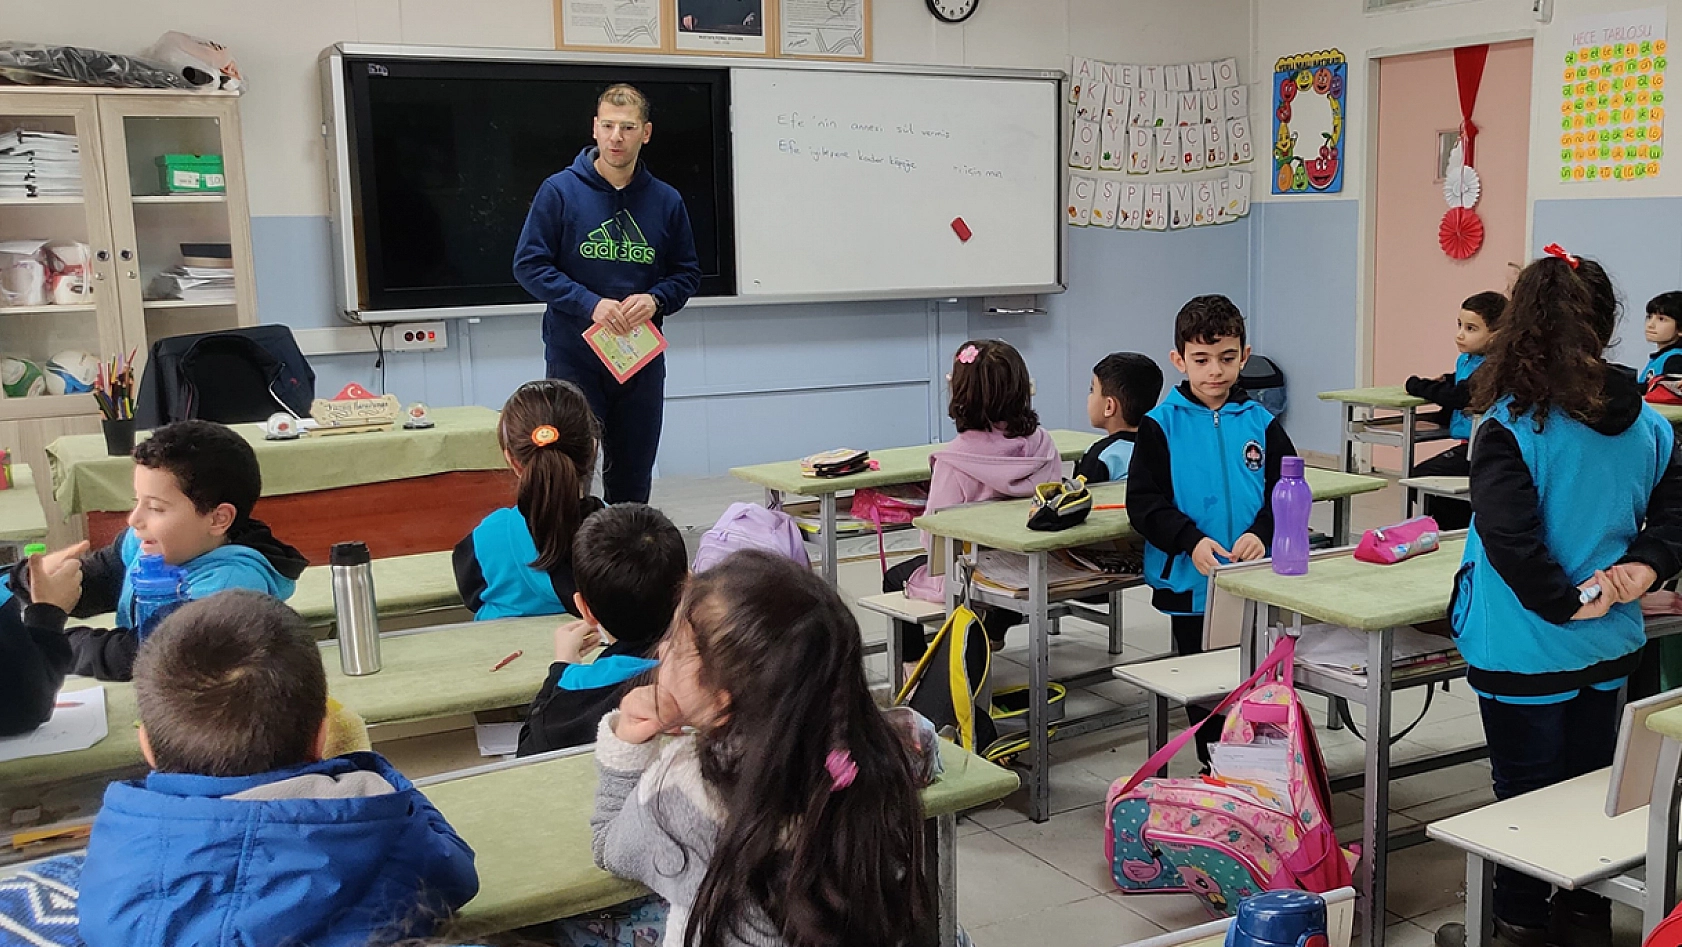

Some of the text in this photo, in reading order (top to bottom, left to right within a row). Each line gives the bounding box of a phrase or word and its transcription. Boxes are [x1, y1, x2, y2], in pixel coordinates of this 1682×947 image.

[1572, 25, 1652, 46] HECE TABLOSU
[1079, 60, 1091, 77] A
[1101, 66, 1113, 84] N
[1123, 68, 1131, 85] E
[1146, 67, 1157, 84] T
[1199, 65, 1208, 81] L
[1219, 64, 1231, 81] O
[1086, 82, 1098, 99] K
[1113, 86, 1125, 105] U
[1139, 90, 1147, 107] R
[1183, 94, 1197, 111] M
[1231, 89, 1240, 106] S
[777, 112, 804, 128] Efe
[778, 139, 801, 154] Efe
[1081, 123, 1093, 143] Ö
[1108, 121, 1118, 141] Y
[1137, 130, 1147, 147] D
[1162, 127, 1173, 145] Z
[1210, 125, 1220, 143] B
[1232, 122, 1244, 139] G
[1113, 150, 1121, 166] y
[1141, 153, 1149, 169] d
[1218, 145, 1225, 161] b
[1242, 142, 1251, 158] g
[1075, 181, 1088, 200] C
[1127, 185, 1136, 203] P
[1151, 187, 1162, 204] H
[1176, 184, 1187, 201] V
[1198, 182, 1211, 203] Ğ
[1220, 180, 1229, 197] F
[1235, 173, 1244, 190] J
[1130, 209, 1140, 226] p
[1157, 209, 1165, 225] h
[1183, 213, 1190, 222] v
[1240, 195, 1247, 214] j
[579, 239, 656, 265] adidas
